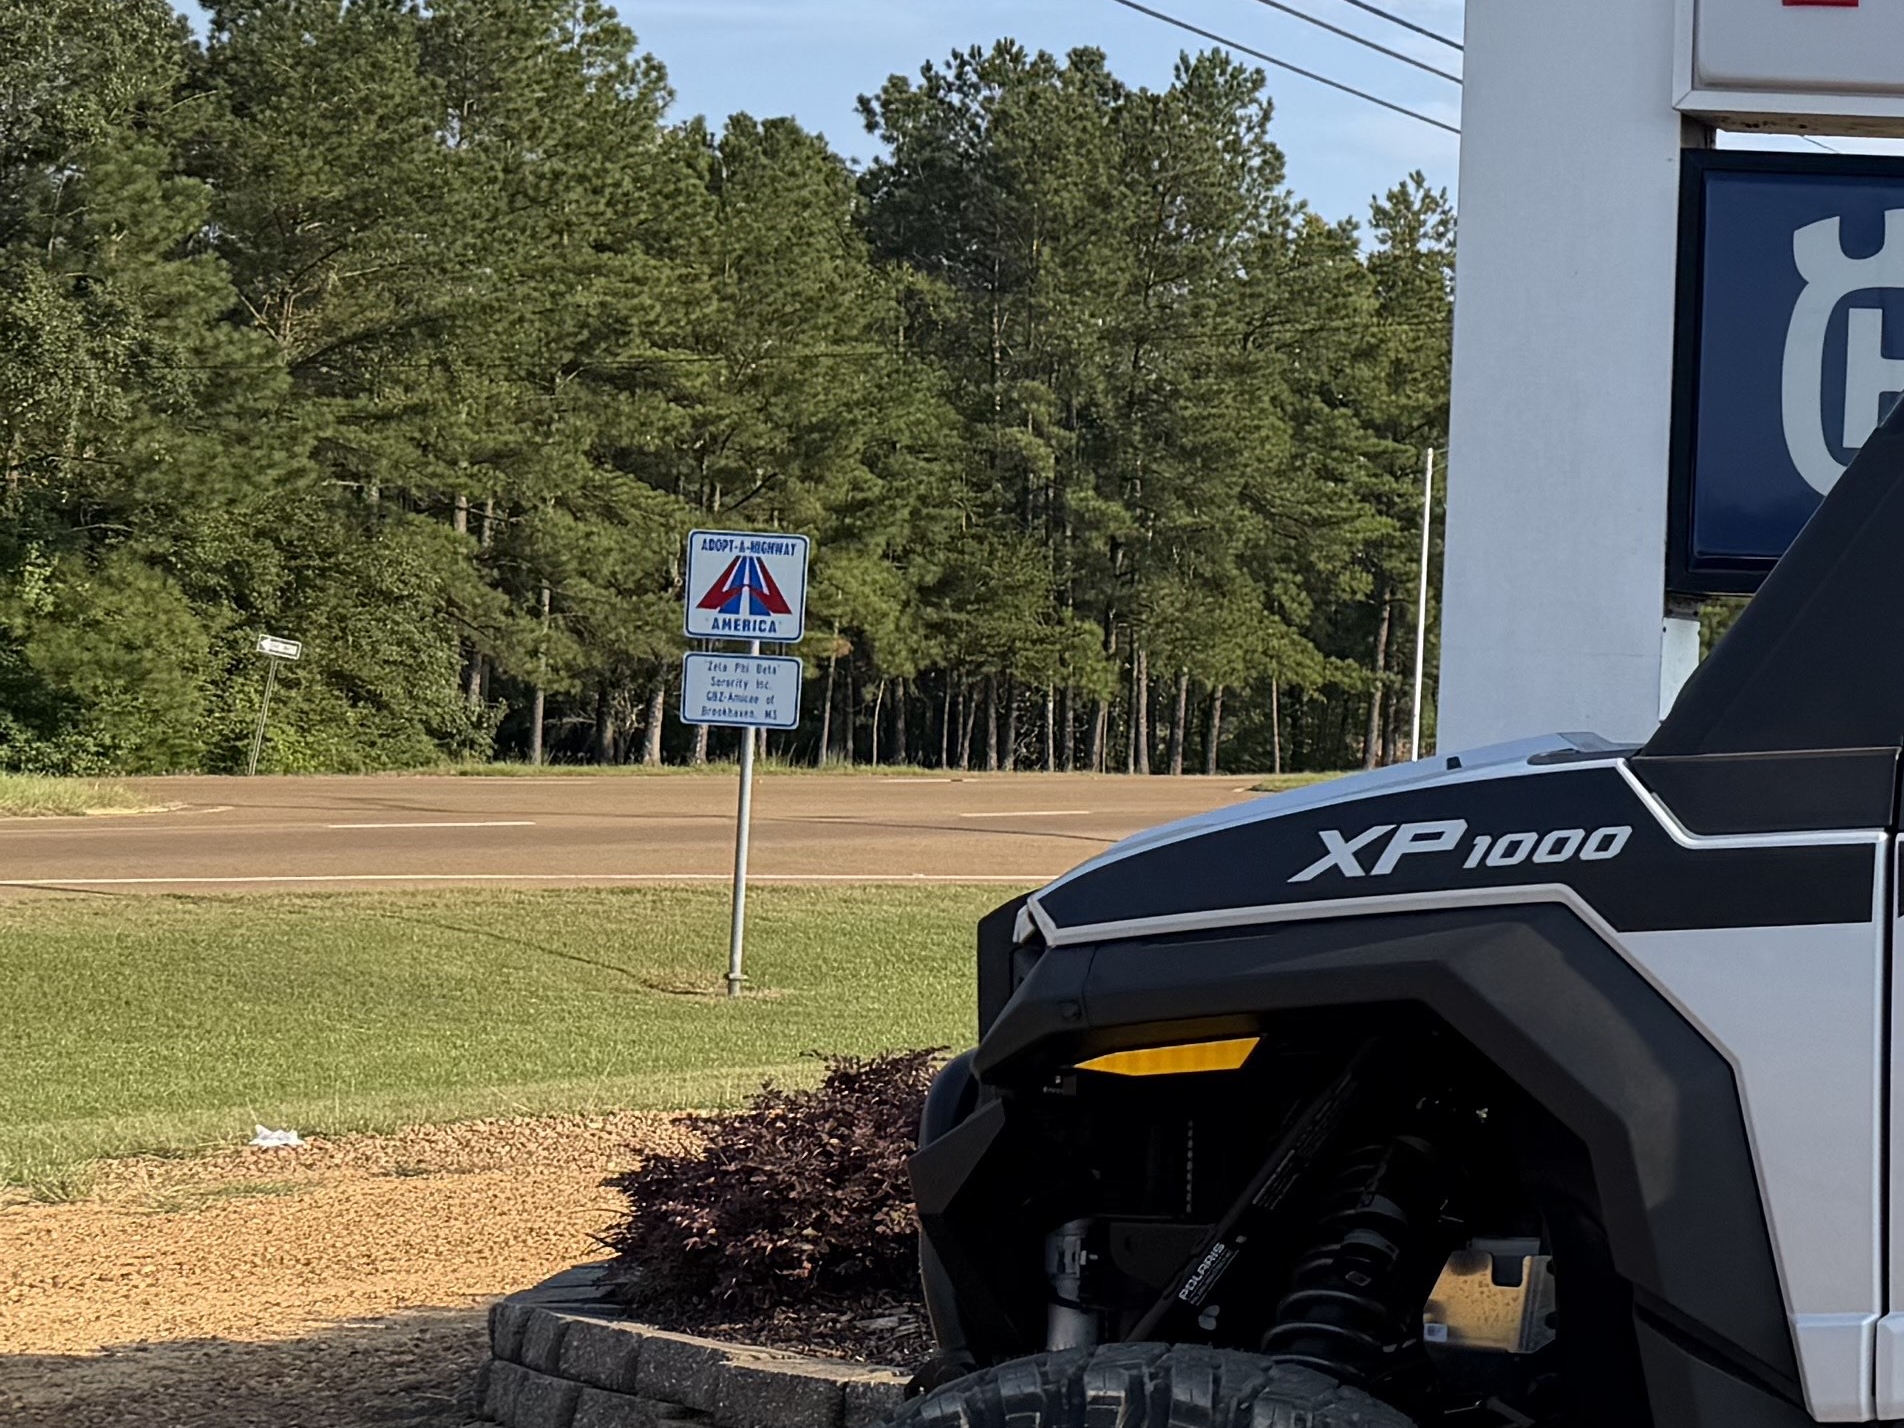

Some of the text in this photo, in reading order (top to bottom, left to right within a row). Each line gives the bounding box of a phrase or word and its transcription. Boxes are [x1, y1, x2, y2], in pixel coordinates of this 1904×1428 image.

[701, 538, 797, 556] ADOPT-A-HIGHWAY
[711, 617, 777, 633] AMERICA
[1178, 1241, 1226, 1301] POLARIS
